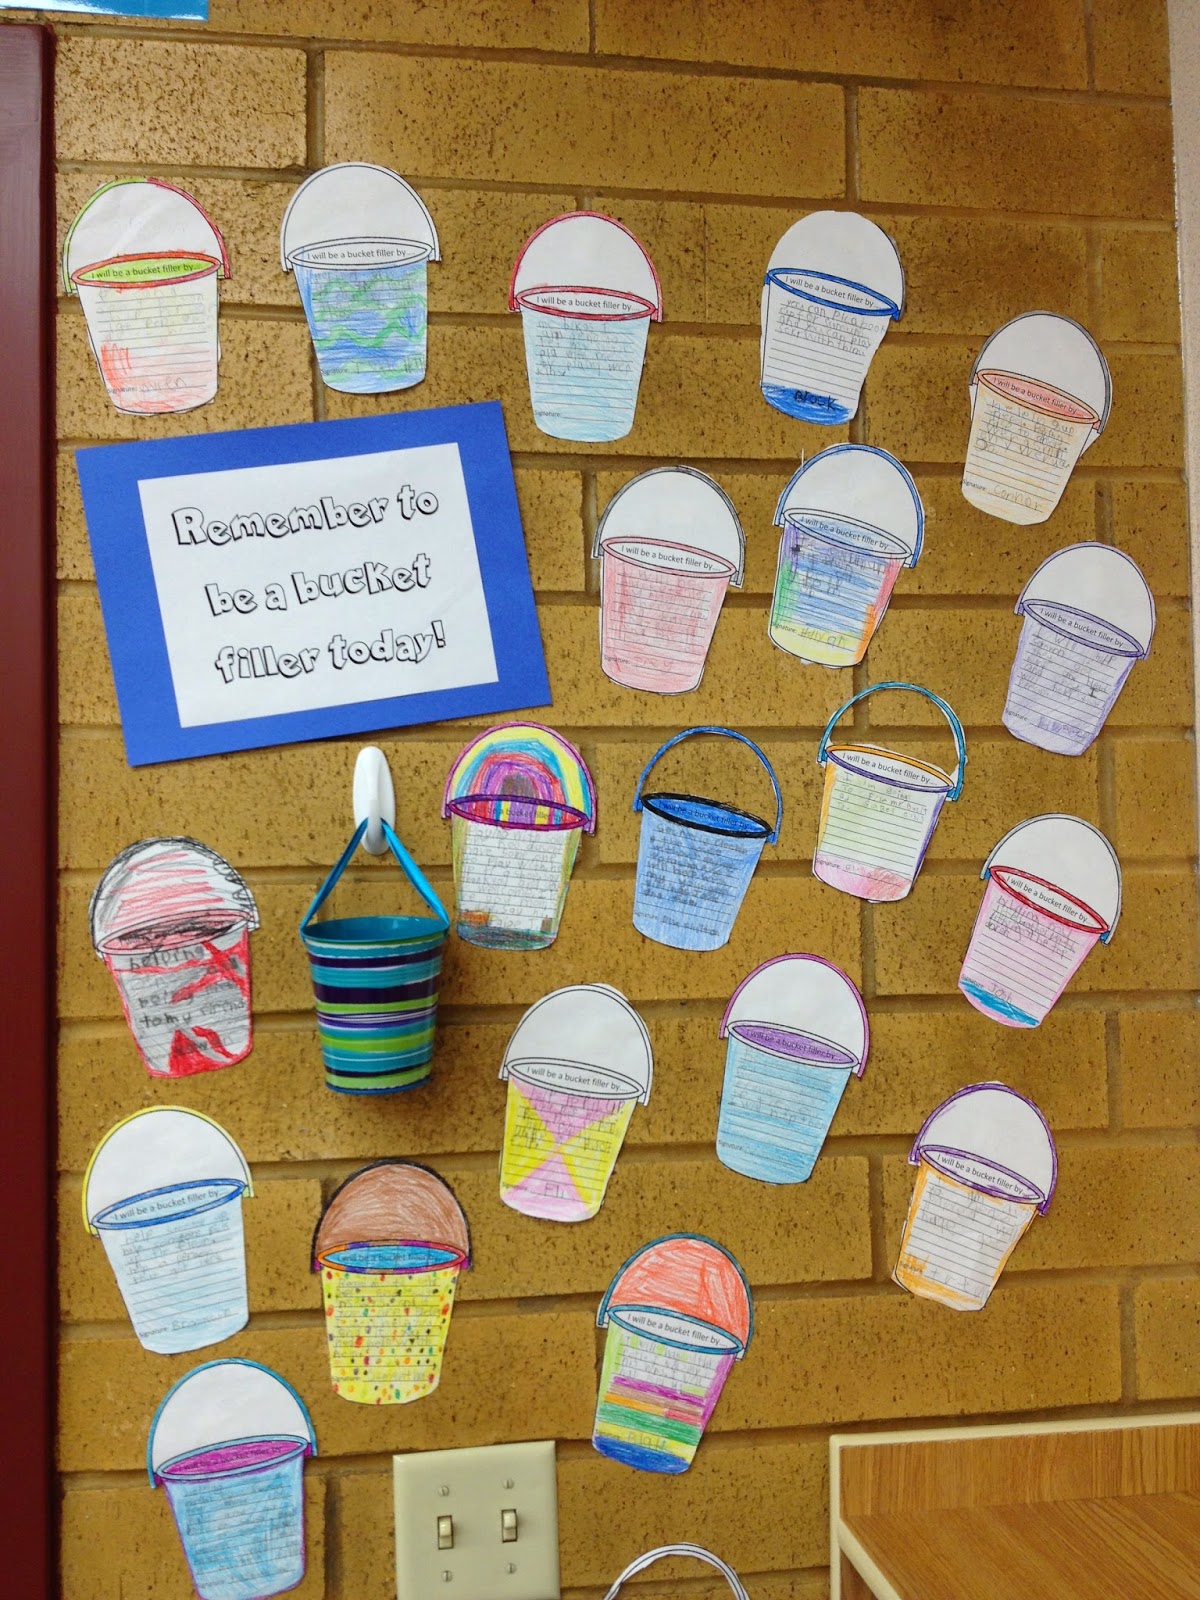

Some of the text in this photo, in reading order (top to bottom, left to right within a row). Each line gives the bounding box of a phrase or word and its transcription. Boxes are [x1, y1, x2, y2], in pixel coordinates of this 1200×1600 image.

[95, 270, 111, 278] will
[132, 266, 161, 275] bucket
[575, 299, 601, 308] bucket
[821, 286, 846, 298] bucket
[847, 294, 864, 303] filler
[998, 380, 1010, 388] will
[1011, 384, 1020, 392] be
[1027, 390, 1051, 404] bucket
[1051, 399, 1068, 410] filler
[172, 484, 440, 546] Remember to
[805, 518, 818, 527] will
[819, 522, 829, 530] be
[836, 527, 861, 540] bucket
[861, 535, 879, 546] filler
[658, 552, 684, 563] bucket
[685, 558, 703, 567] filler
[205, 553, 432, 616] be a bucket
[1045, 611, 1058, 620] will
[1057, 615, 1067, 624] be
[1073, 622, 1098, 636] bucket
[1098, 632, 1114, 642] filler
[214, 620, 446, 683] filler today!
[878, 763, 902, 775] bucket
[903, 770, 920, 780] filler
[1011, 878, 1024, 888] will
[1023, 884, 1033, 893] be
[1039, 892, 1062, 909] bucket
[1062, 905, 1078, 917] filler
[564, 1074, 591, 1084] bucket
[592, 1079, 610, 1088] filler
[942, 1157, 955, 1166] will
[955, 1161, 965, 1170] be
[971, 1168, 996, 1183] bucket
[996, 1178, 1014, 1189] filler
[119, 1210, 135, 1219] will
[156, 1198, 186, 1210] bucket
[187, 1193, 207, 1202] filler
[632, 1316, 646, 1324] will
[647, 1319, 657, 1327] be
[664, 1324, 691, 1336] bucket
[692, 1331, 710, 1341] filler
